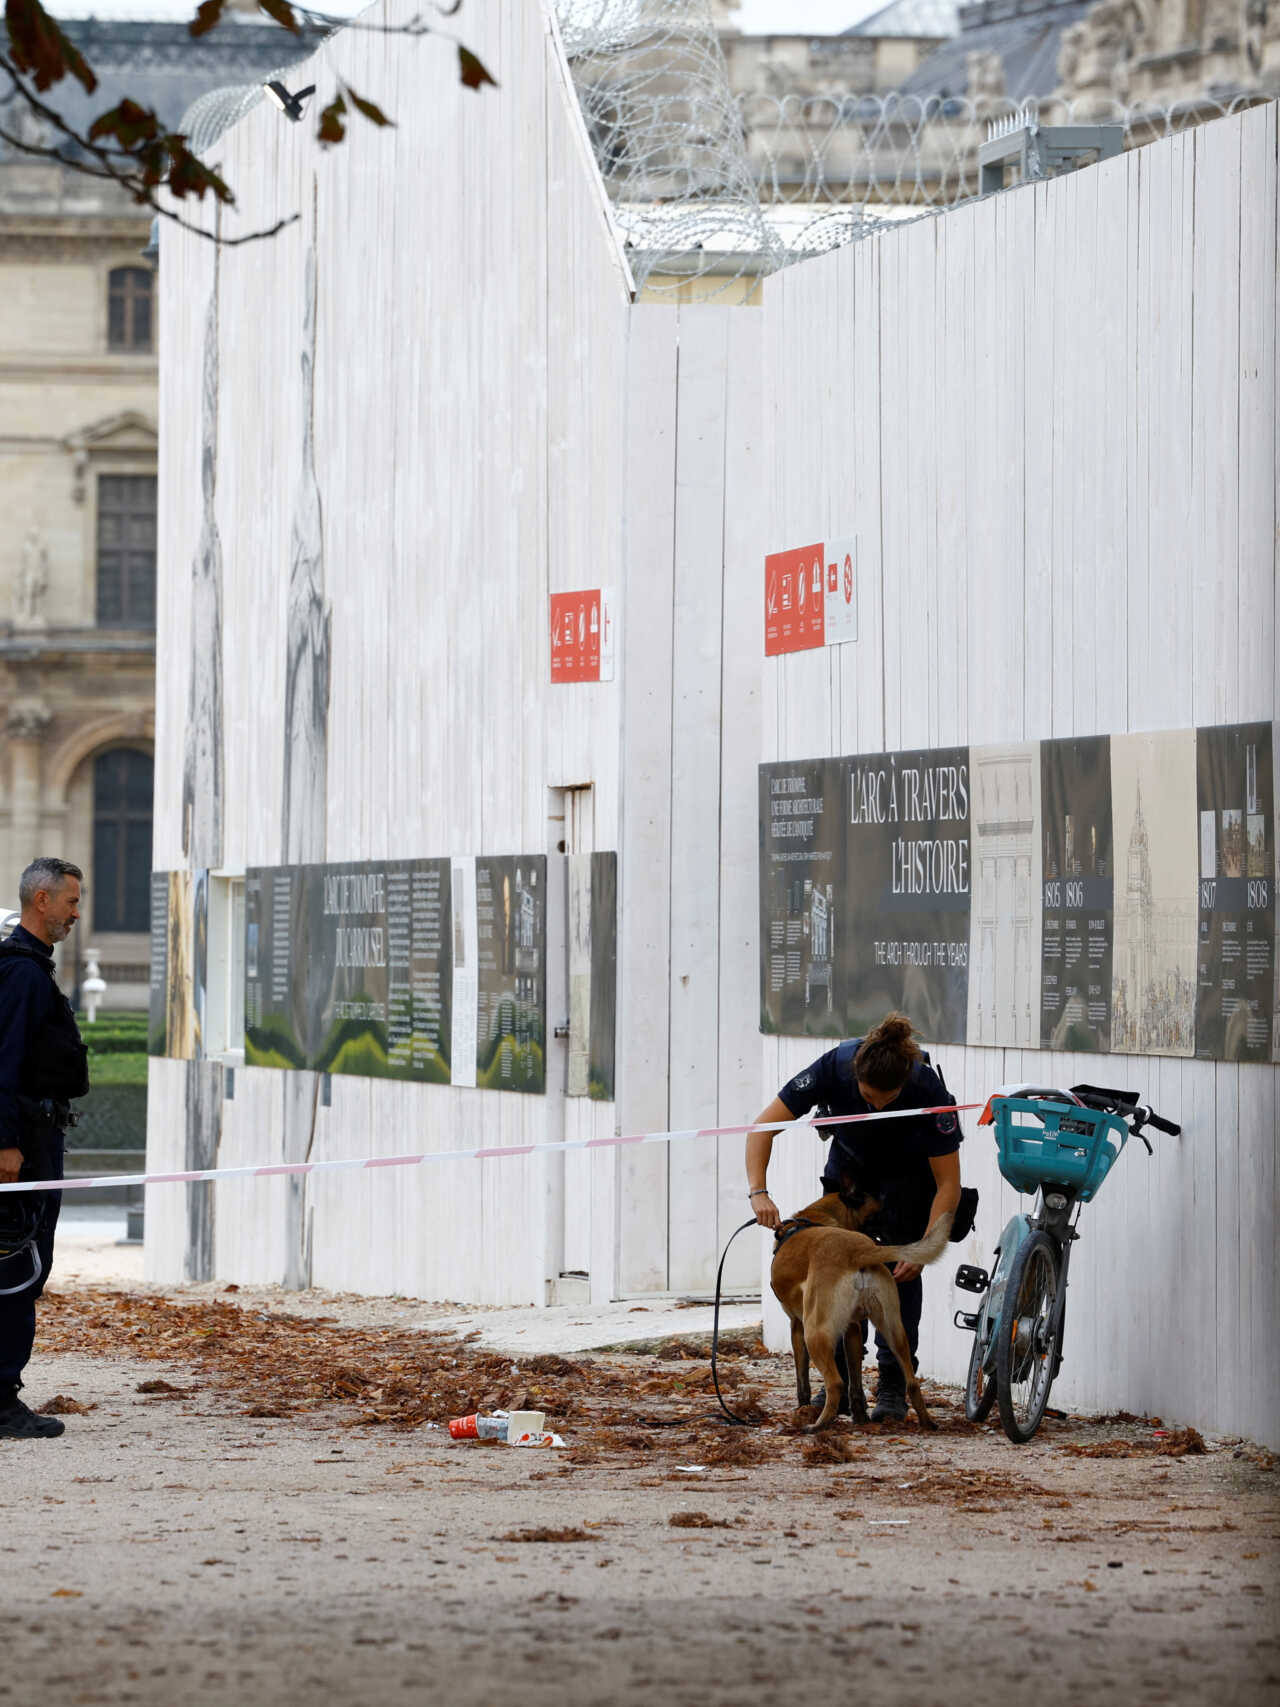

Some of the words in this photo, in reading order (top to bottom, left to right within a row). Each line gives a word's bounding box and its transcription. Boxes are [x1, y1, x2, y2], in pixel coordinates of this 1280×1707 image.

[851, 768, 886, 823] L'ARC
[888, 755, 898, 822] À
[901, 765, 968, 821] TRAVERS
[892, 837, 969, 894] L'HISTOIRE
[1045, 882, 1061, 907] 1805
[1066, 882, 1083, 907] 1806
[1201, 881, 1217, 909] 1807
[1248, 880, 1268, 909] 1808
[874, 942, 886, 965] THE
[887, 942, 902, 965] ARCH
[903, 942, 932, 966] THROUGH
[933, 942, 946, 966] THE
[946, 942, 968, 966] YEARS
